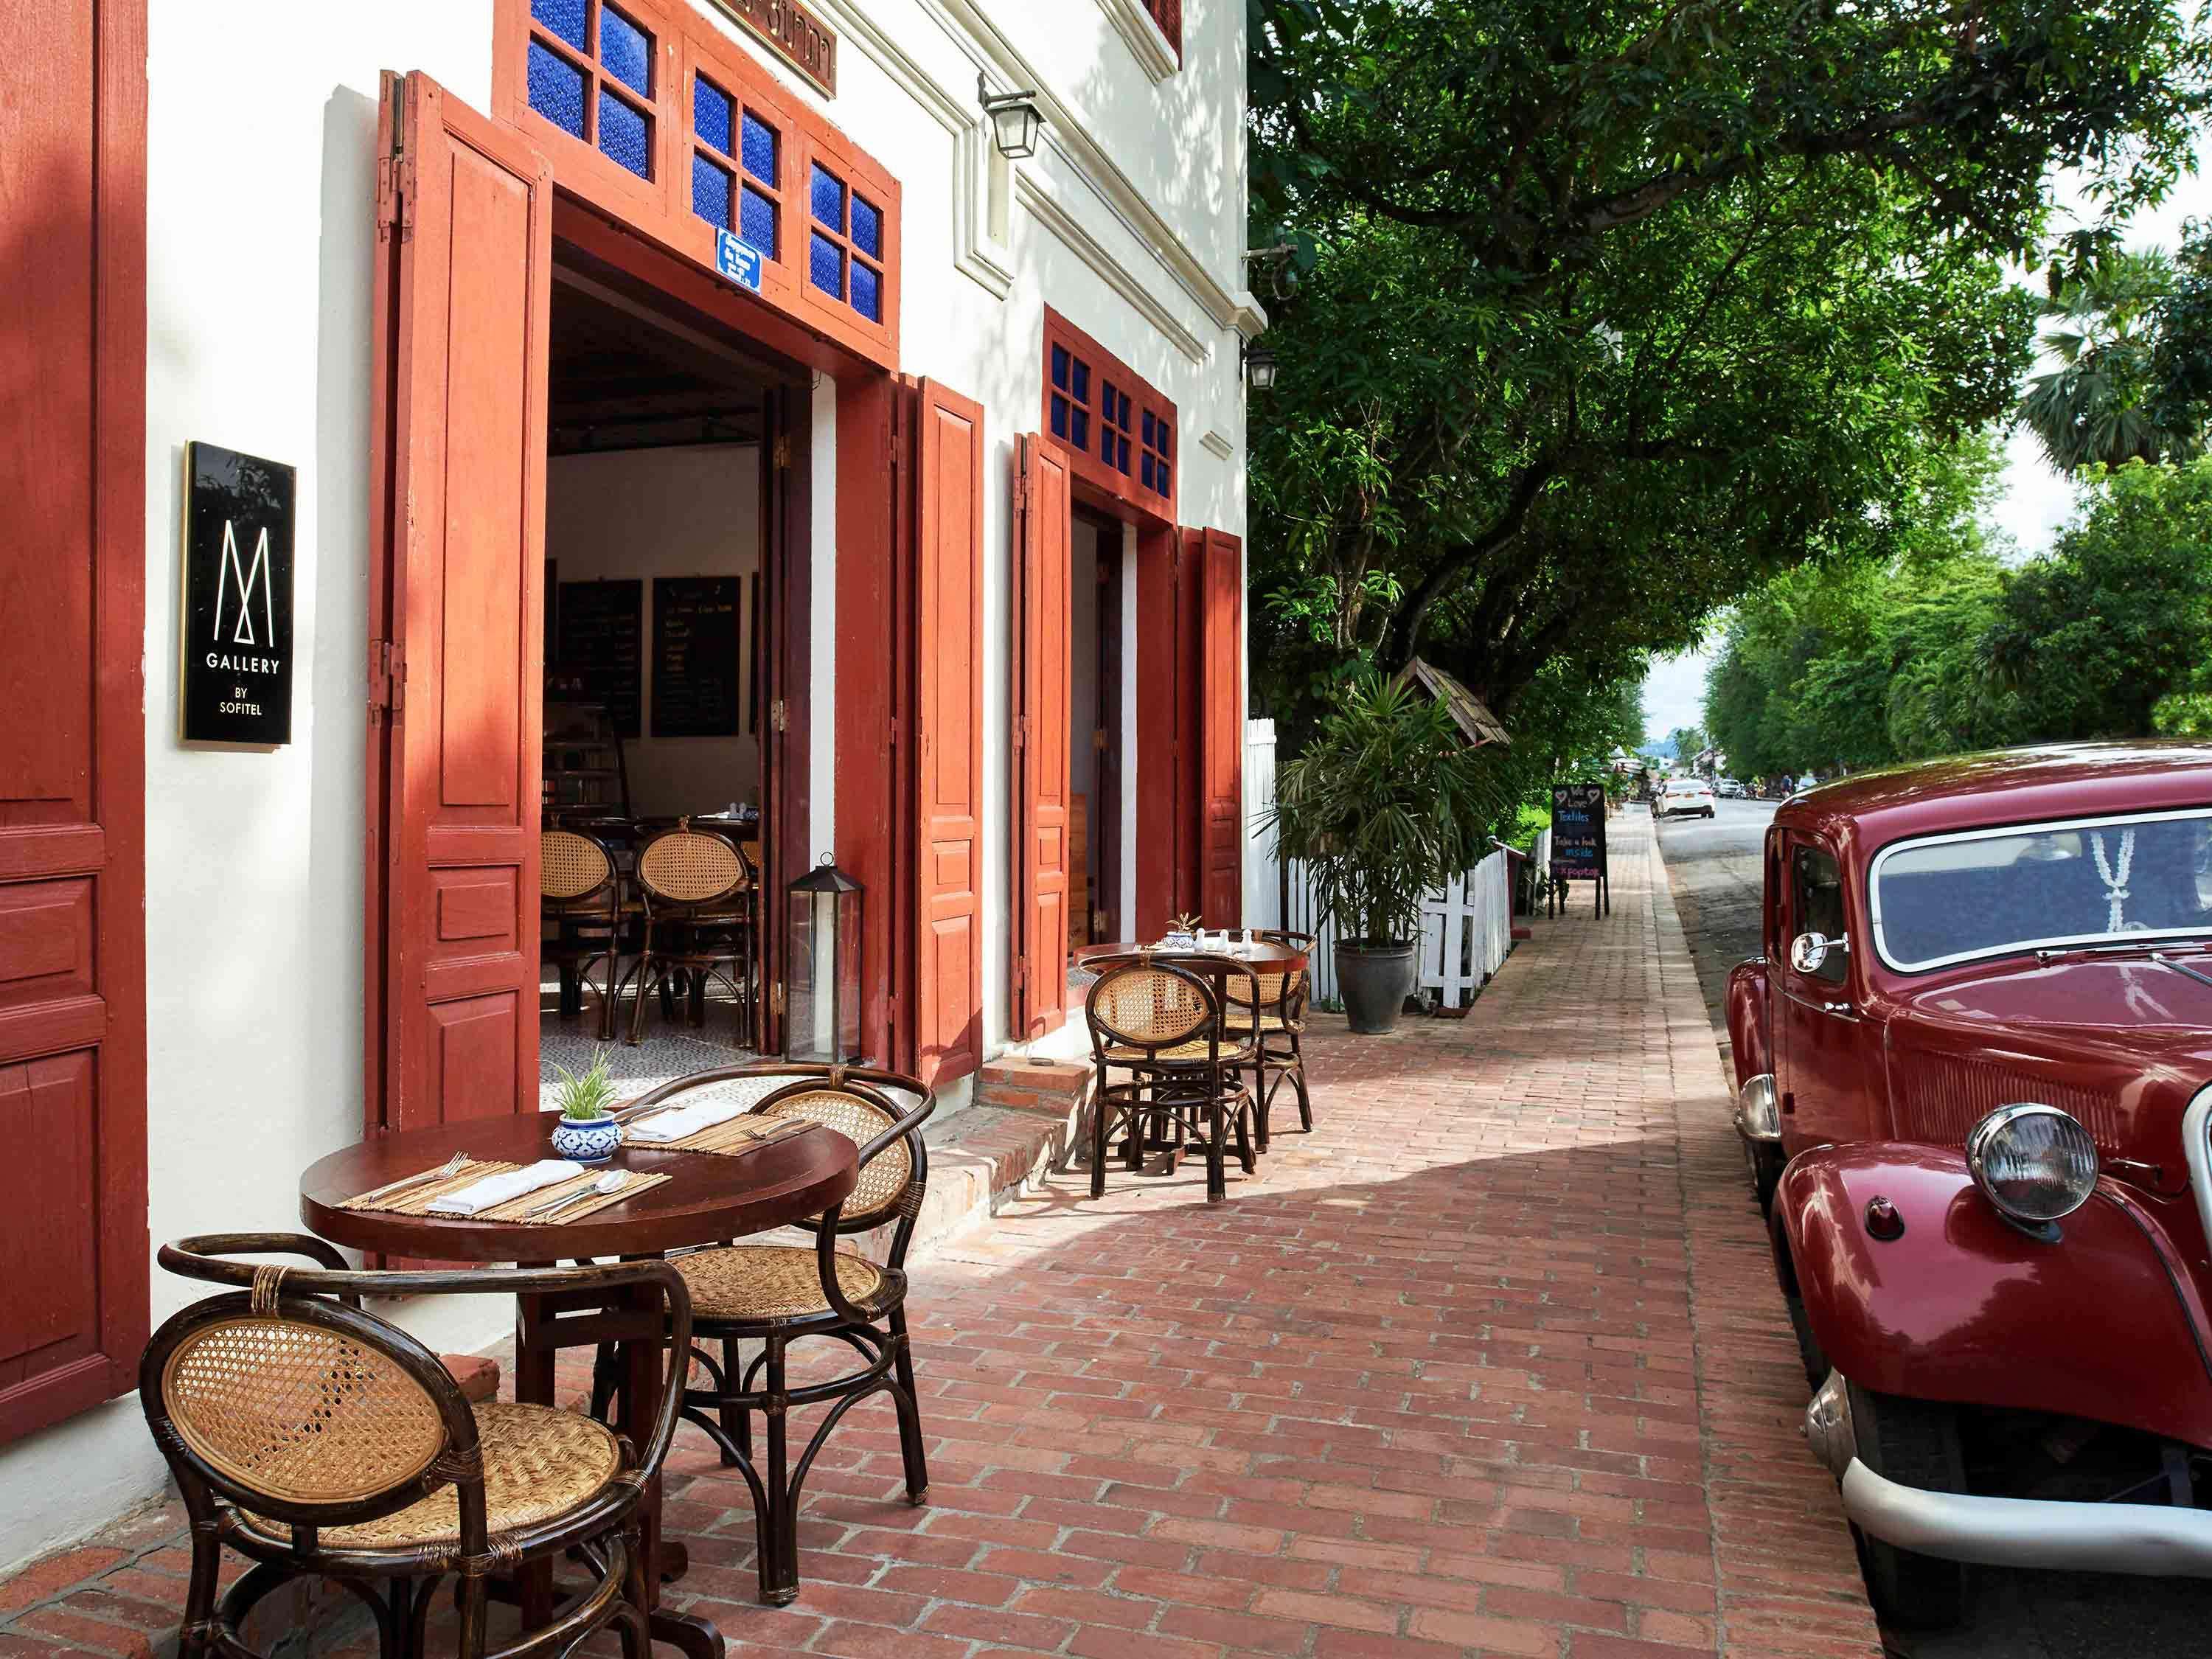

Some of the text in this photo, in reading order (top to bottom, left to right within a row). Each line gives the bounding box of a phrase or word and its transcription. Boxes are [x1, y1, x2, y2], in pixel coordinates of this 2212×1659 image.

[206, 653, 279, 675] GALLERY
[235, 687, 248, 699] BY
[220, 701, 262, 716] SOFITEL
[1557, 810, 1590, 822] Textiles
